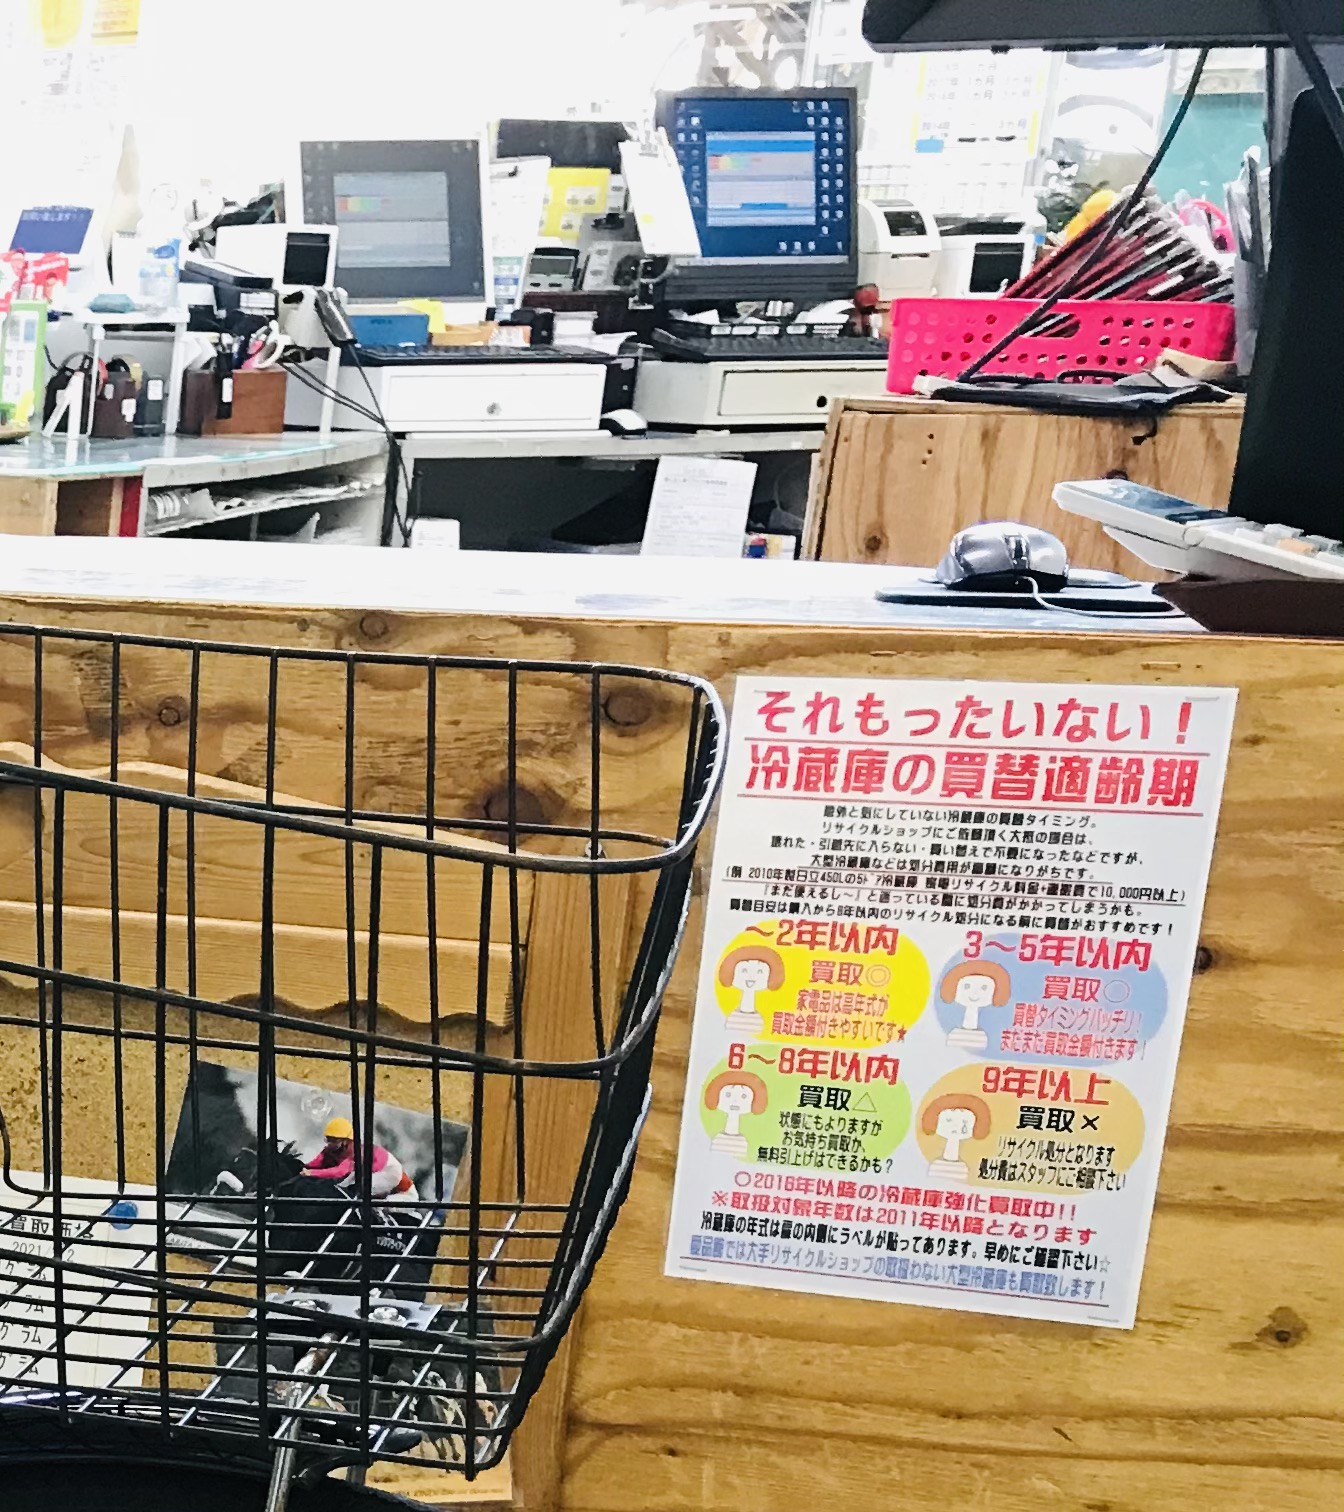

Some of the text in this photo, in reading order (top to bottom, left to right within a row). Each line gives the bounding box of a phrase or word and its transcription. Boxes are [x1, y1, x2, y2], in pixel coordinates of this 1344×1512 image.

[756, 690, 1192, 745] それもったいない！
[744, 743, 1200, 807] 冷蔵庫の買替適齢期
[981, 1066, 1113, 1106] 9年以上
[778, 1111, 884, 1137] 状態にもよりますが
[998, 1136, 1116, 1167] リサイクル処分となります
